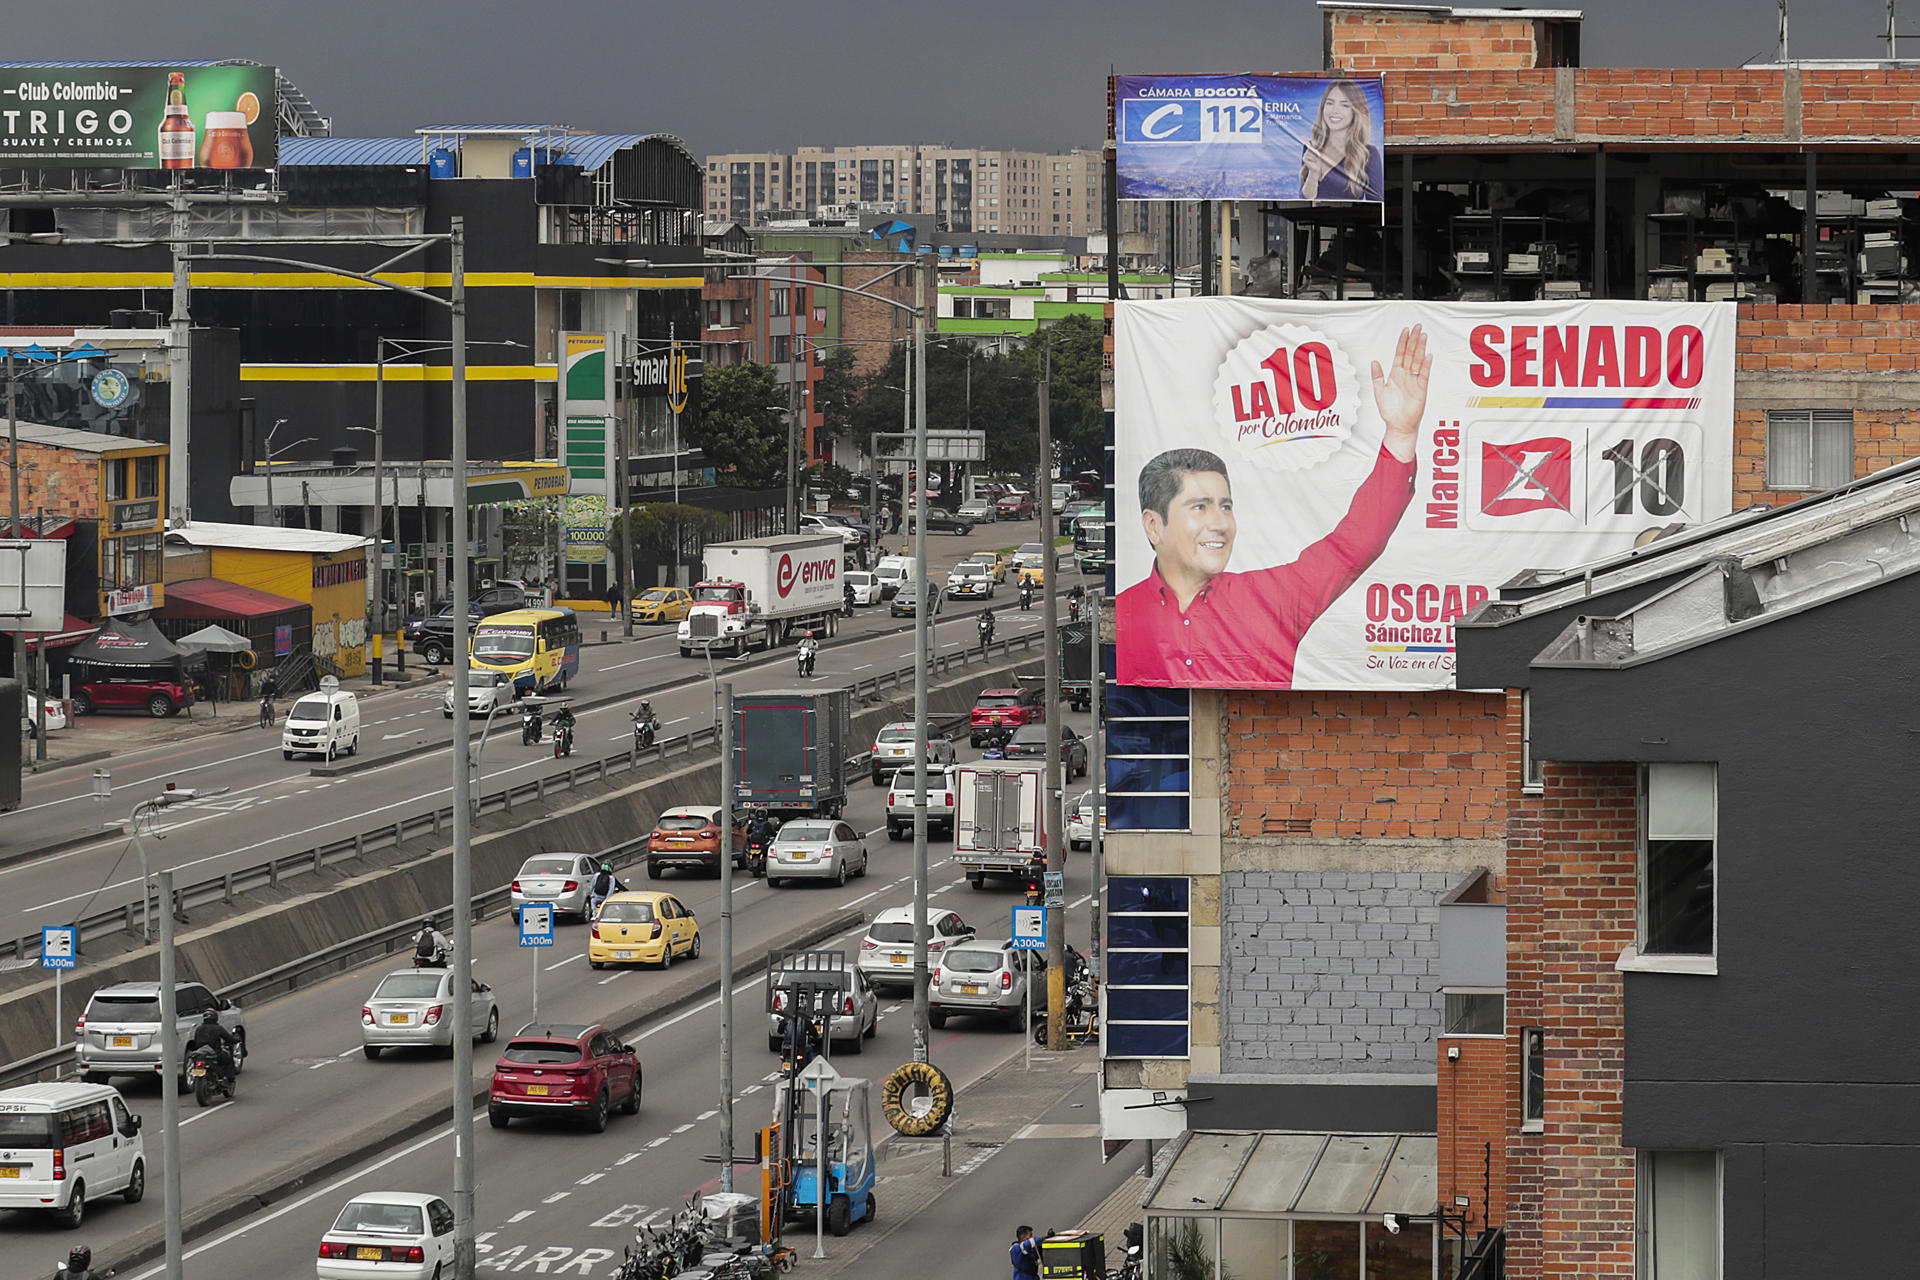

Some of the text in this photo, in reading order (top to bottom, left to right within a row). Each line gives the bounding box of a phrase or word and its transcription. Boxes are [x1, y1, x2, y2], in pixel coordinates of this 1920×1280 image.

[19, 81, 118, 101] Club Colombia
[1138, 85, 1258, 98] CÁMARA BOGOTÁ
[1206, 105, 1261, 133] 112
[1265, 102, 1301, 113] ERIKA
[3, 109, 133, 135] TRIGO
[2, 138, 133, 147] SUAVE Y CREMOSA
[1469, 324, 1704, 389] SENADO
[633, 354, 669, 387] smart
[1230, 341, 1338, 423] LA 10
[1237, 408, 1341, 442] por Colombia
[534, 474, 565, 490] PETROBRAS
[1425, 419, 1461, 529] Marca:
[1601, 437, 1686, 517] 10
[570, 531, 605, 541] 100.000
[1365, 623, 1441, 643] Sánchez
[1366, 655, 1384, 669] Su
[1389, 655, 1408, 670] Voz
[1411, 659, 1426, 669] en
[1428, 655, 1441, 669] el
